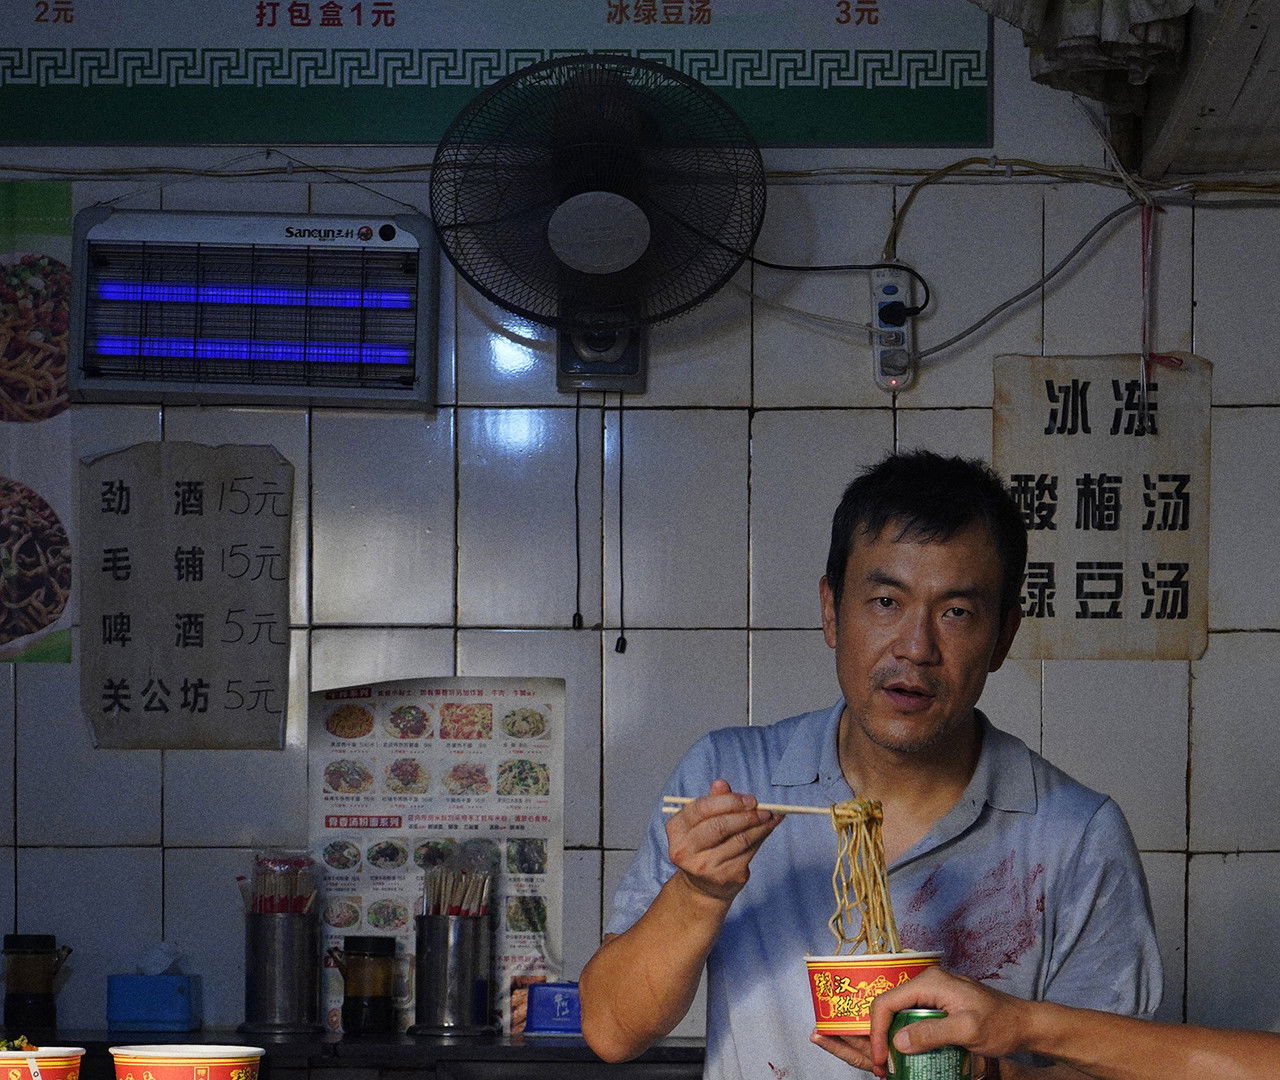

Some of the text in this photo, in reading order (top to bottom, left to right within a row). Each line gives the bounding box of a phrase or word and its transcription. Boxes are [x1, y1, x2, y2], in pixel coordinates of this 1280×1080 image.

[35, 0, 75, 25] 2元
[255, 1, 396, 28] 打包盒1元
[606, 0, 880, 26] 冰绿豆汤 3元
[1044, 379, 1159, 436] 冰冻
[101, 476, 290, 519] 劲酒 15元
[1011, 473, 1191, 532] 酸梅汤
[101, 544, 287, 582] 毛铺 15元
[101, 608, 286, 648] 啤酒 5元
[101, 677, 283, 715] 关公坊 5元
